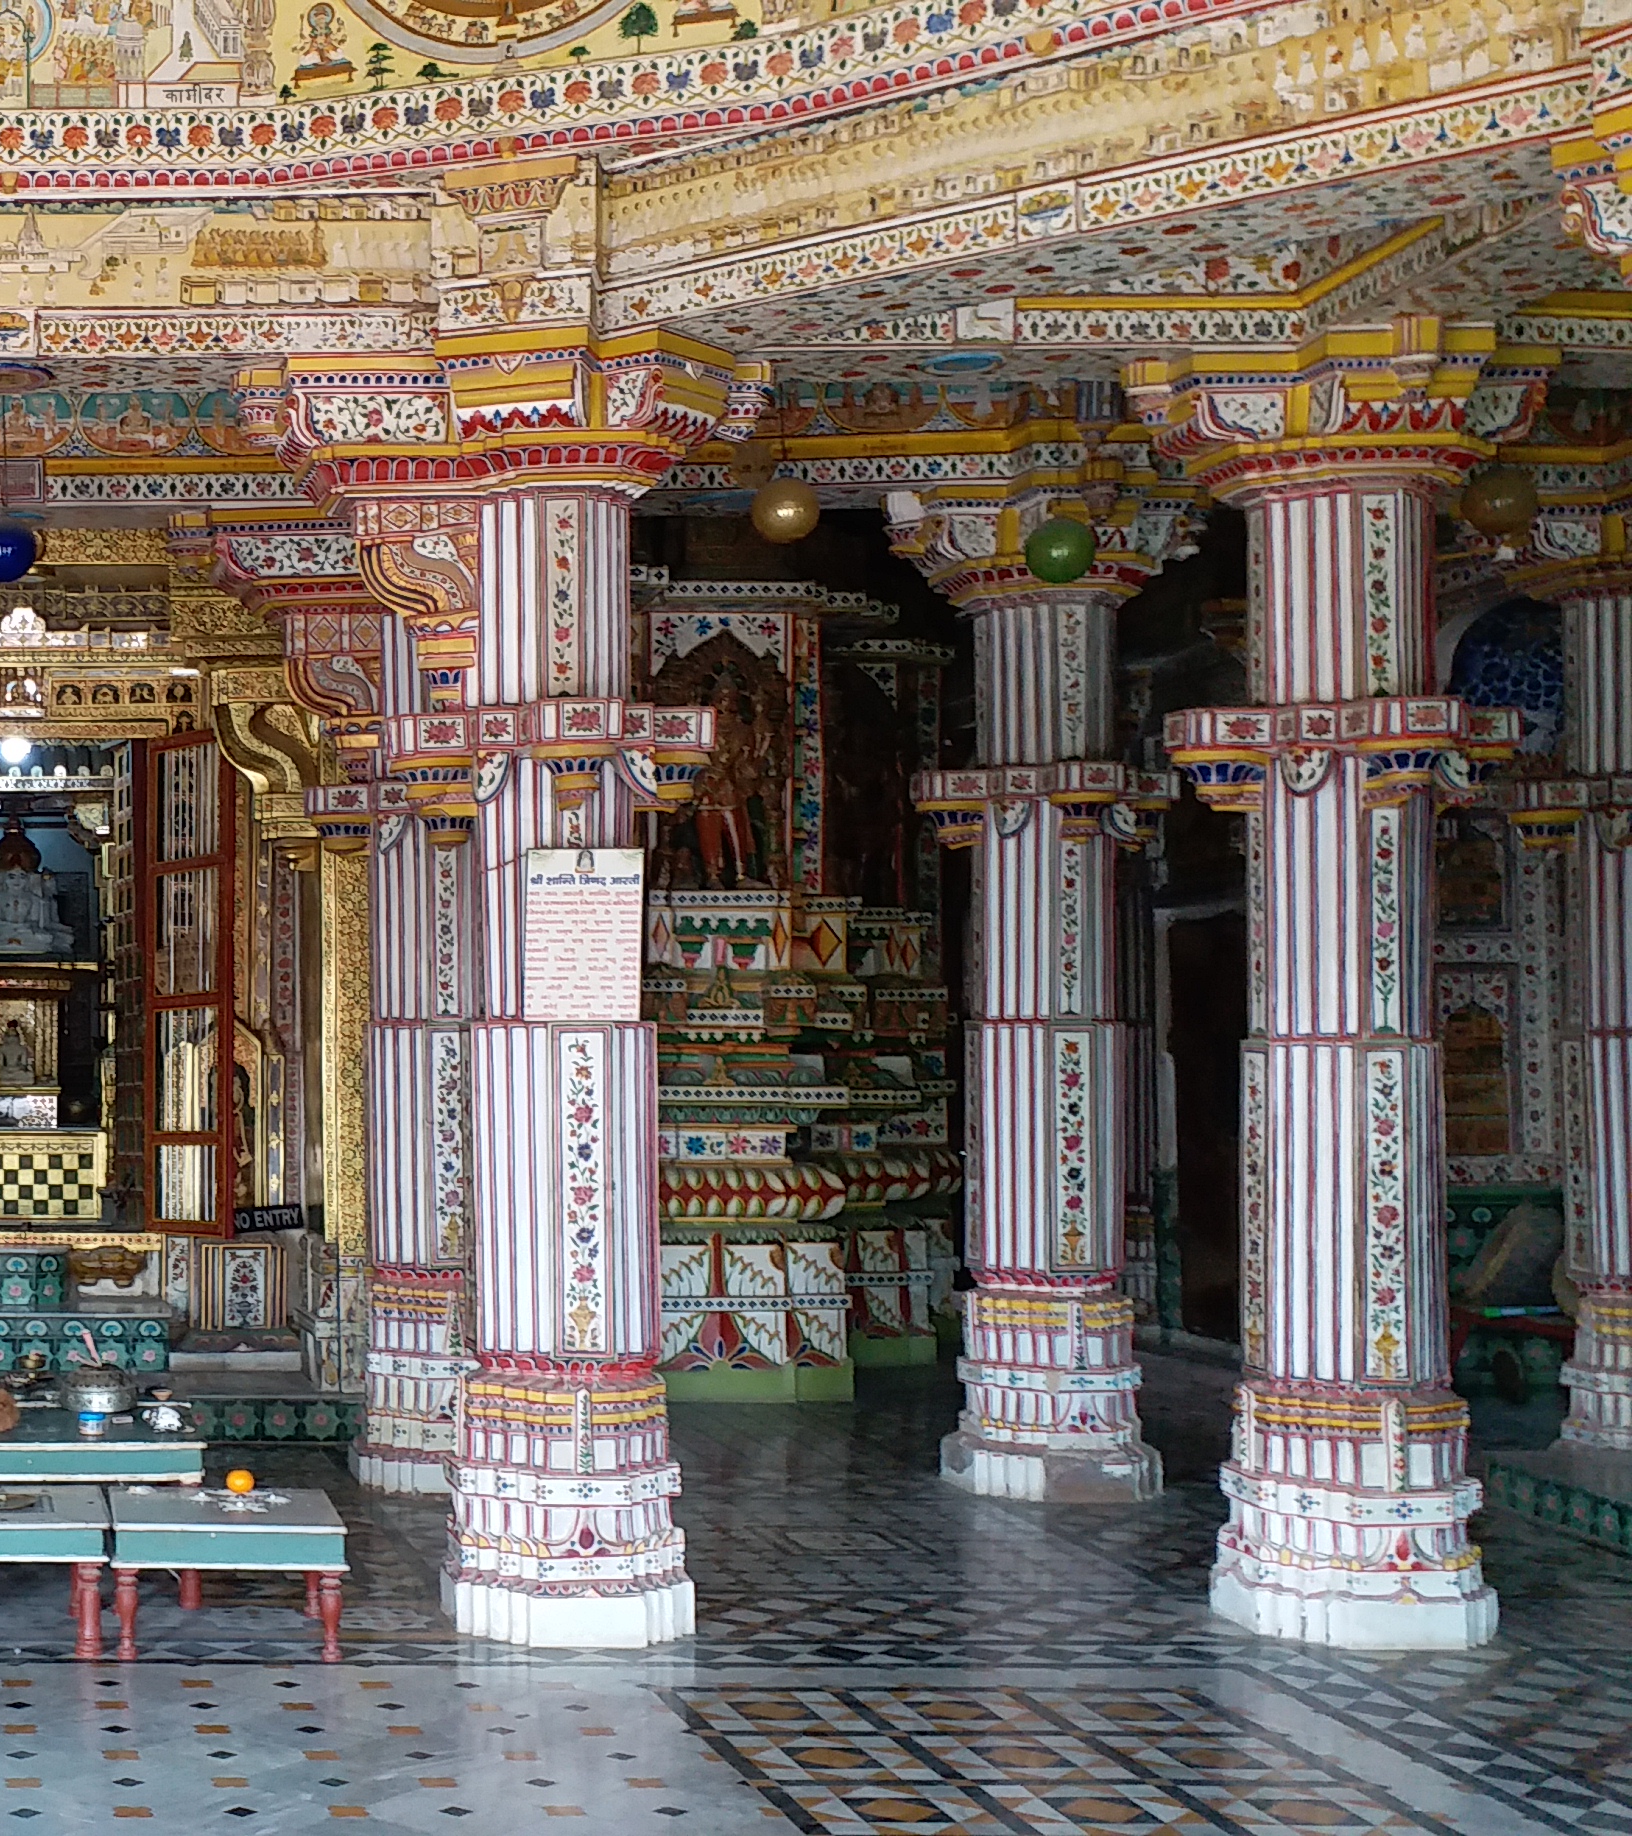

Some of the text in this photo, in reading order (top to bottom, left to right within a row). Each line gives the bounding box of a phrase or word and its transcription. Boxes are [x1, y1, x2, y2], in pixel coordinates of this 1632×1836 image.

[530, 873, 544, 886] श्री
[609, 873, 641, 886] आरती
[253, 1207, 299, 1228] ENTRY
